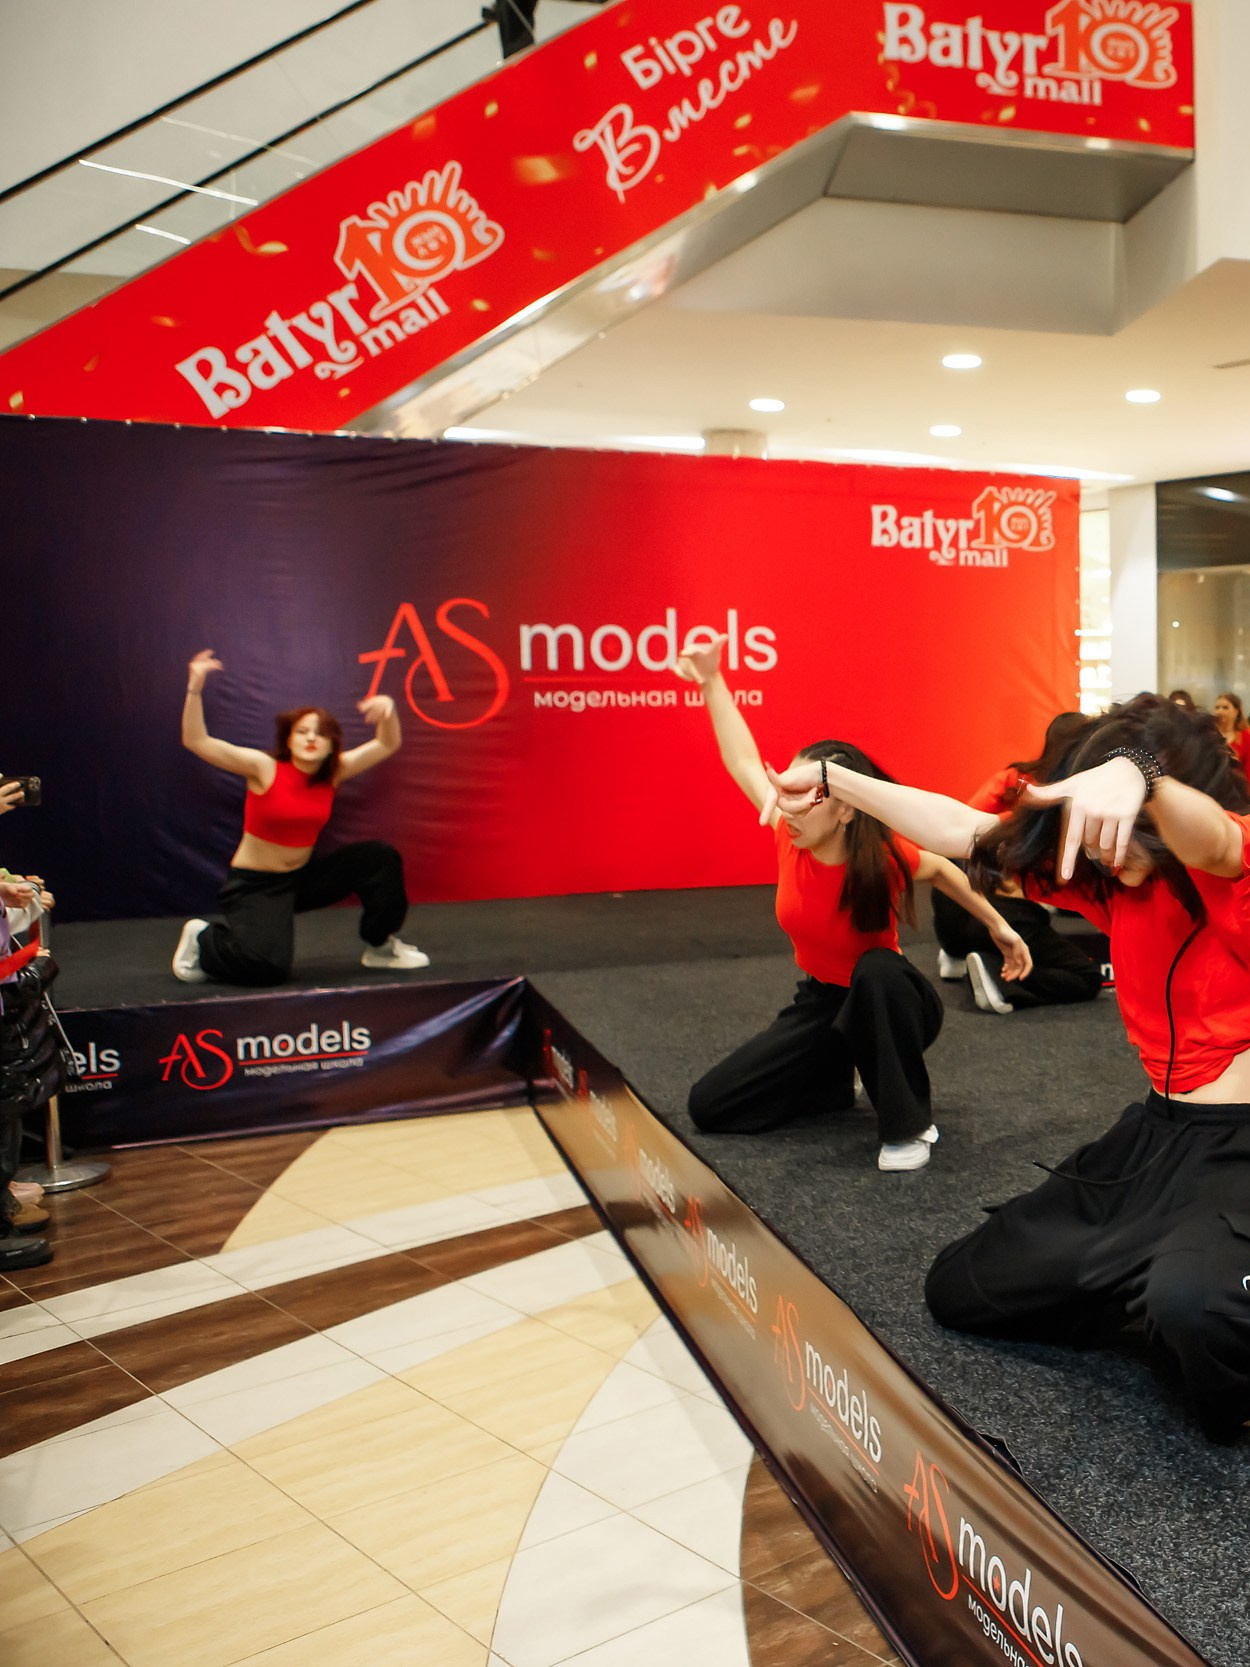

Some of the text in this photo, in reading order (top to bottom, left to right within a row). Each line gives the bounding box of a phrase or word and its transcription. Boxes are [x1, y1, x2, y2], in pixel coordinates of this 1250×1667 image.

[620, 5, 751, 90] Бірге
[882, 2, 1050, 96] Batyr
[572, 18, 798, 203] Вместе
[1024, 77, 1102, 106] mall
[175, 282, 365, 419] Batyr
[360, 286, 451, 357] mall
[871, 504, 975, 566] Batyr
[958, 549, 1009, 568] mall
[358, 598, 510, 729] AS
[534, 689, 763, 713] модельная шла
[159, 1020, 371, 1091] AS models
[707, 1227, 758, 1314] models
[805, 1341, 882, 1463] models
[904, 1450, 958, 1600] AS
